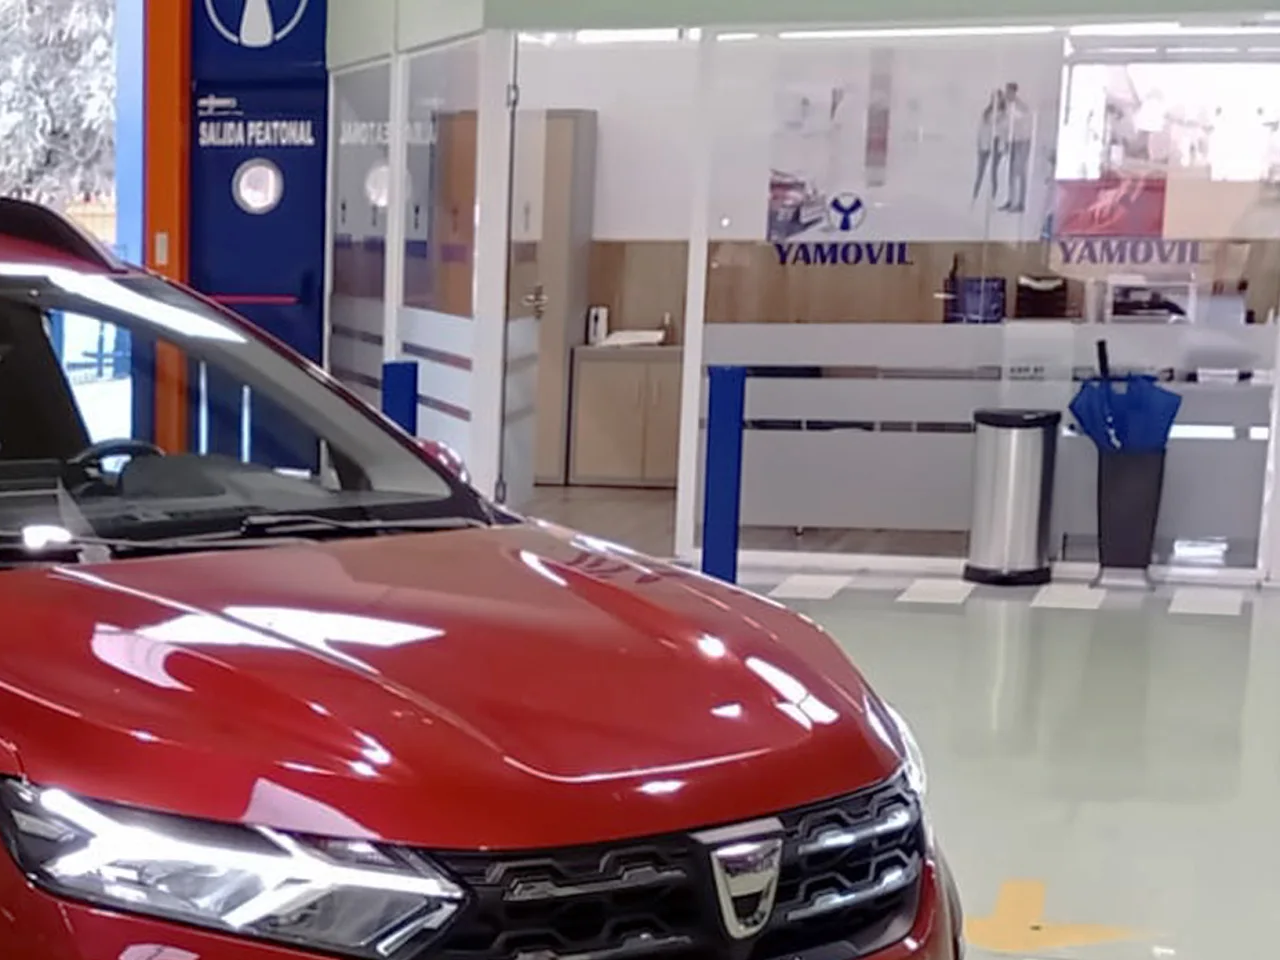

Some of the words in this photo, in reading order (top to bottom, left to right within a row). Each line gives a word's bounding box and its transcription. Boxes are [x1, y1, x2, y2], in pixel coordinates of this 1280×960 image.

[198, 121, 245, 146] SALIDA
[247, 121, 315, 146] PEATONAL
[774, 241, 914, 266] YAMOVIL
[1059, 239, 1211, 265] YAMOVIL
